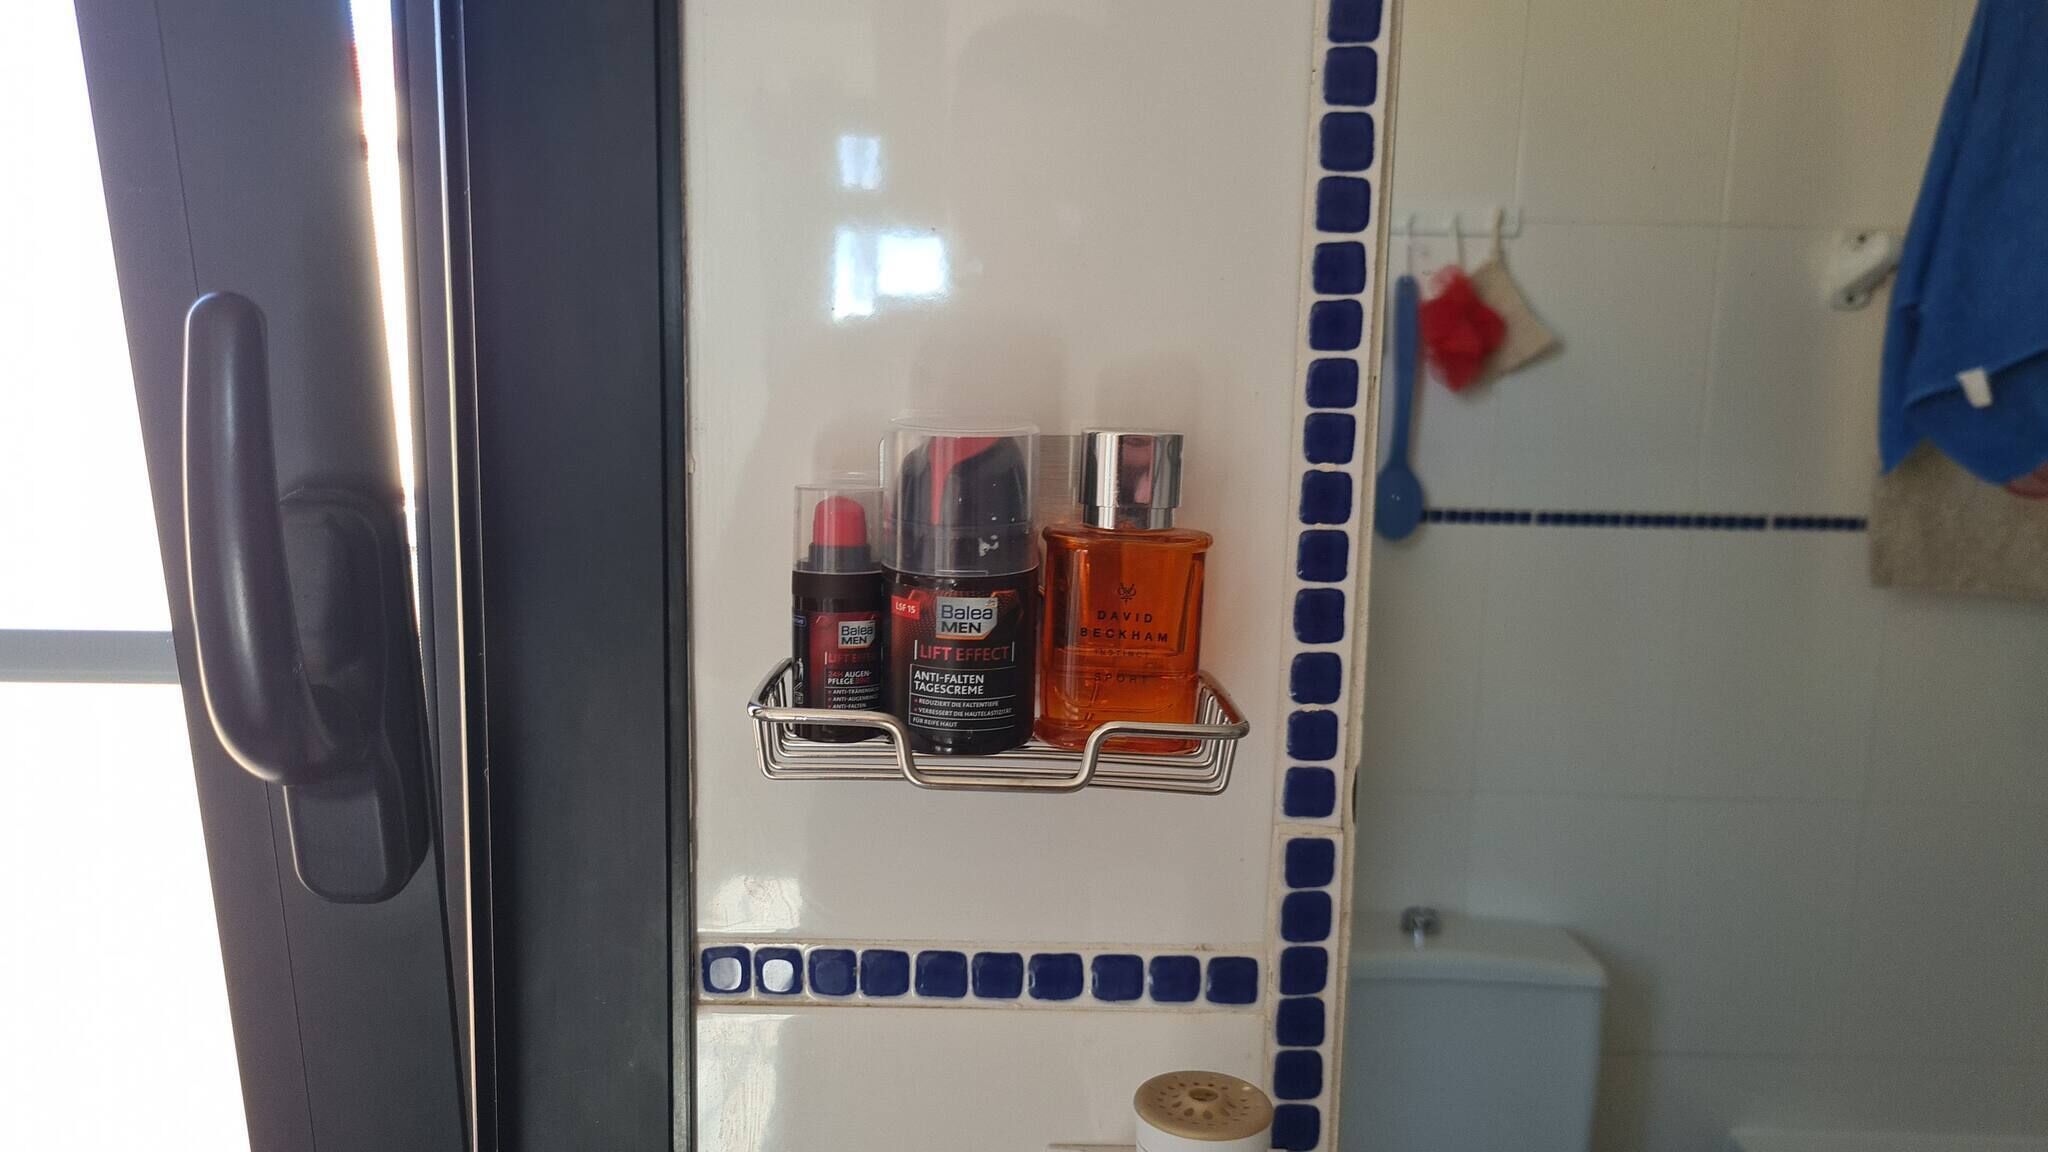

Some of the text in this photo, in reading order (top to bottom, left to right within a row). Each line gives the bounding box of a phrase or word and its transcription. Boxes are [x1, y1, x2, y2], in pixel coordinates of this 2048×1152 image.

[895, 602, 916, 614] LSF 15
[941, 604, 992, 620] Balea
[1097, 610, 1154, 623] DAVID
[841, 625, 873, 636] Balea
[941, 622, 981, 634] MEN
[841, 636, 867, 645] MEN
[1080, 627, 1169, 643] BECKHAM
[920, 645, 1010, 661] LIFT EFFECT
[844, 670, 872, 678] AUGEN-
[914, 669, 984, 684] ANTI-FALTEN
[1094, 672, 1147, 683] SPORT
[827, 677, 855, 685] PFLEGE
[914, 681, 984, 695] TAGESCREME
[918, 698, 950, 707] REDUZIERT
[918, 707, 952, 716] VERBESSERT
[912, 716, 923, 724] FÜR
